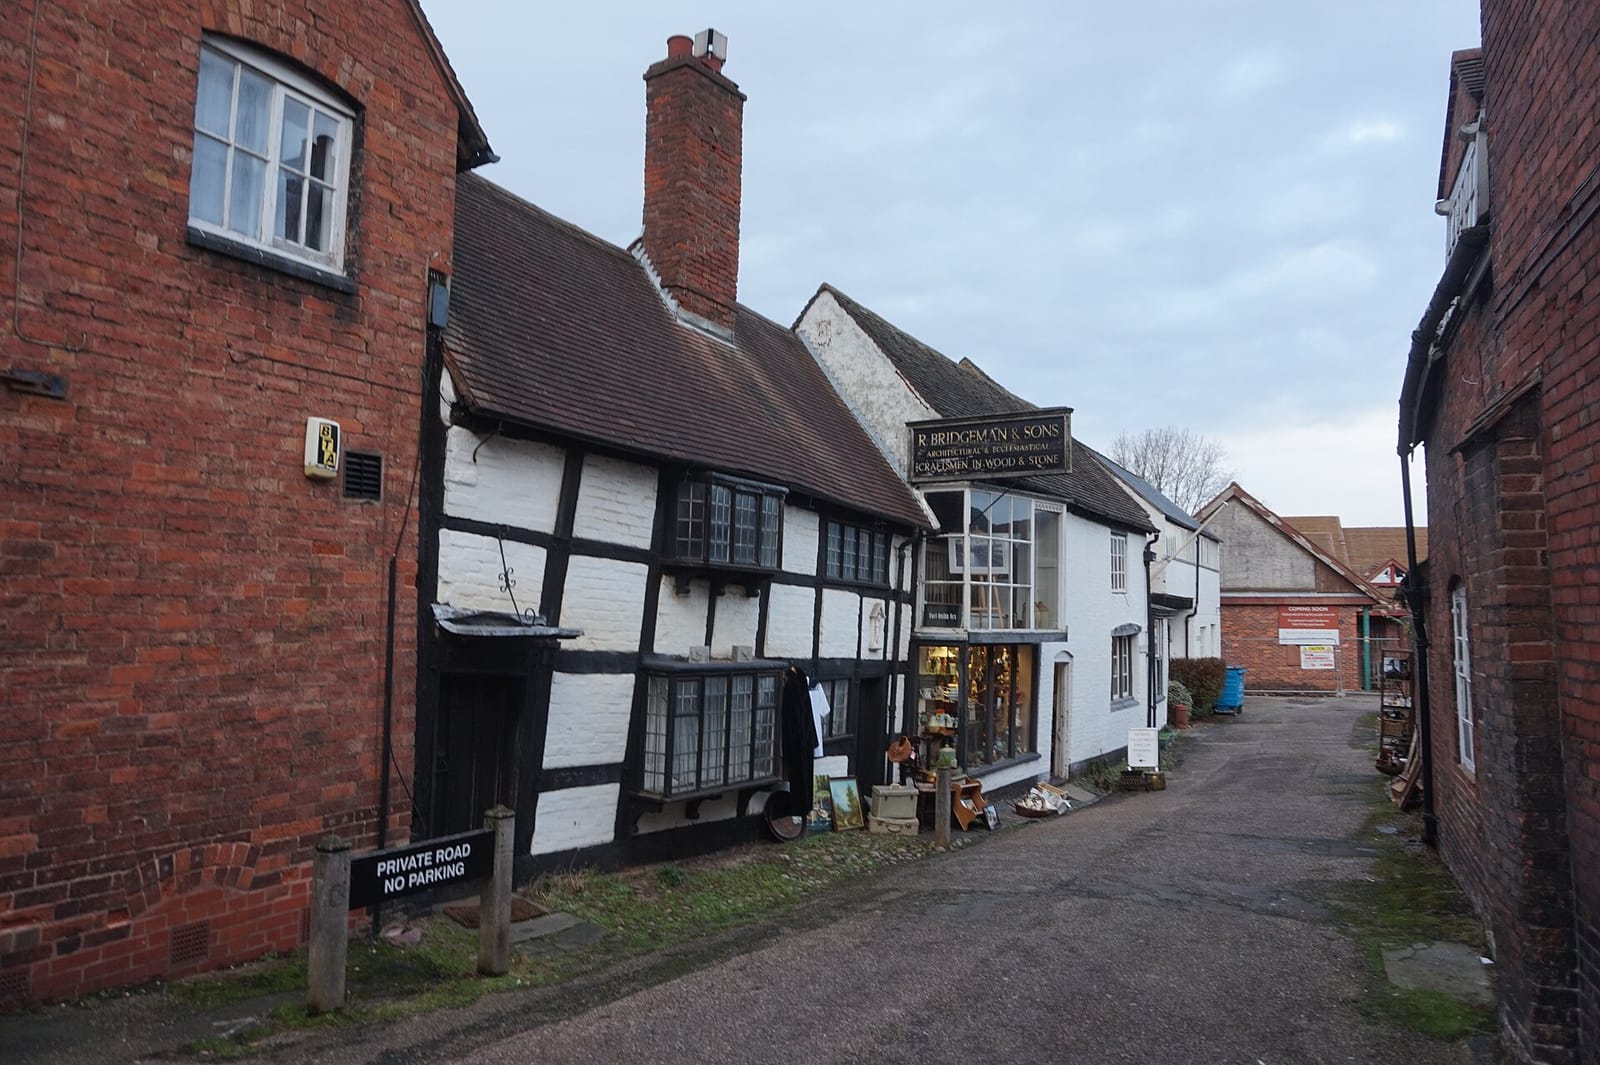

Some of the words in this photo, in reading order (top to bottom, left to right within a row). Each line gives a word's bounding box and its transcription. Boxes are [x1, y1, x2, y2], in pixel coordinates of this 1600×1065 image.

[931, 427, 1007, 445] BRIDGEMAN
[1012, 427, 1020, 440] &
[1024, 424, 1059, 439] SONS
[927, 447, 981, 458] ARCHITECTURAL
[992, 443, 1049, 454] ECCLESIASTICAL
[972, 459, 982, 468] IN
[985, 457, 1016, 469] WOOD
[1018, 456, 1025, 466] &
[1028, 454, 1059, 465] STONE
[377, 851, 433, 877] PRIVATE
[436, 843, 471, 863] ROAD
[384, 876, 405, 894] NO
[408, 862, 465, 888] PARKING
